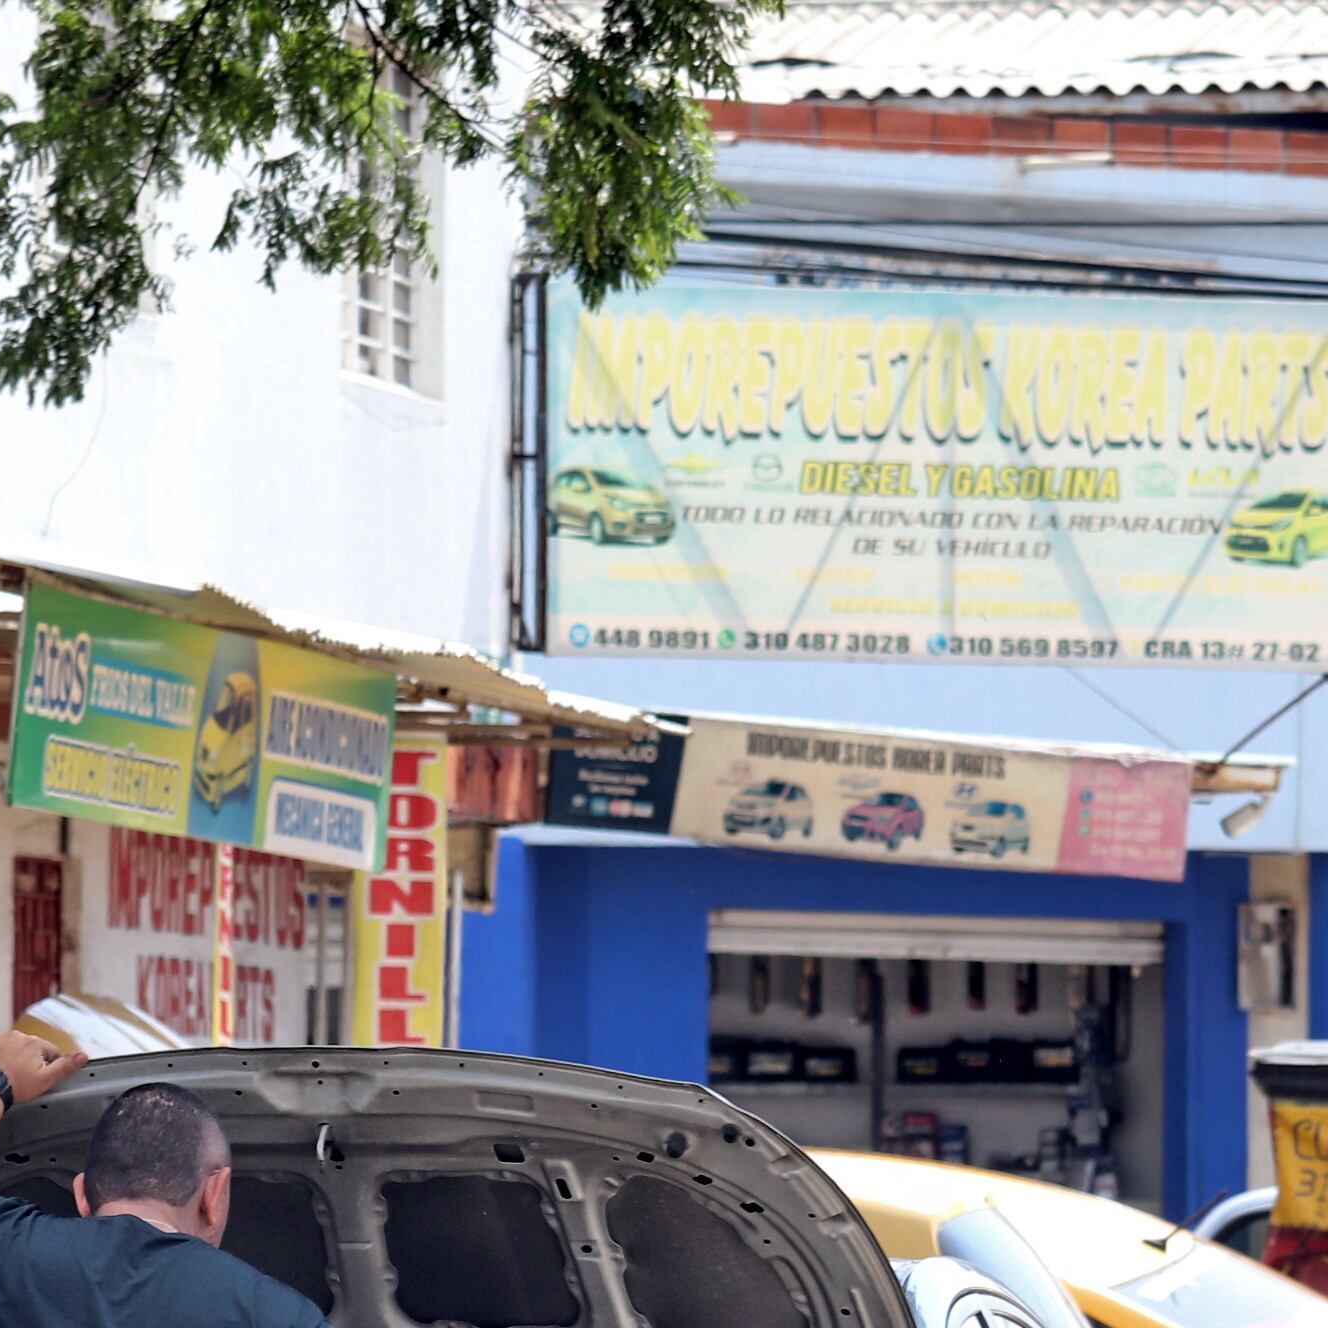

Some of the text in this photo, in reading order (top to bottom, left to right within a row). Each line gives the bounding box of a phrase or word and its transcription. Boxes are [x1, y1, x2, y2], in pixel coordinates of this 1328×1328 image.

[566, 311, 997, 446] IMPOREPUESTOS
[998, 319, 1169, 455] KOREA
[800, 460, 1121, 502] DIESEL Y GASOLINA
[682, 505, 1224, 536] TODO LO RELACIONADO CON LA REPARACIÓN
[852, 537, 1051, 560] DE SU VEHÍCULO
[593, 628, 640, 648] 448
[647, 629, 710, 650] 9891
[744, 630, 789, 651] 310
[796, 631, 840, 652] 487
[846, 633, 910, 653] 3028
[948, 636, 993, 656] 310
[1000, 637, 1050, 658] 569
[1057, 638, 1119, 659] 8597
[1143, 640, 1192, 660] CRA
[1252, 642, 1320, 662] 27-02
[106, 824, 306, 950] IMPOREPESTOS
